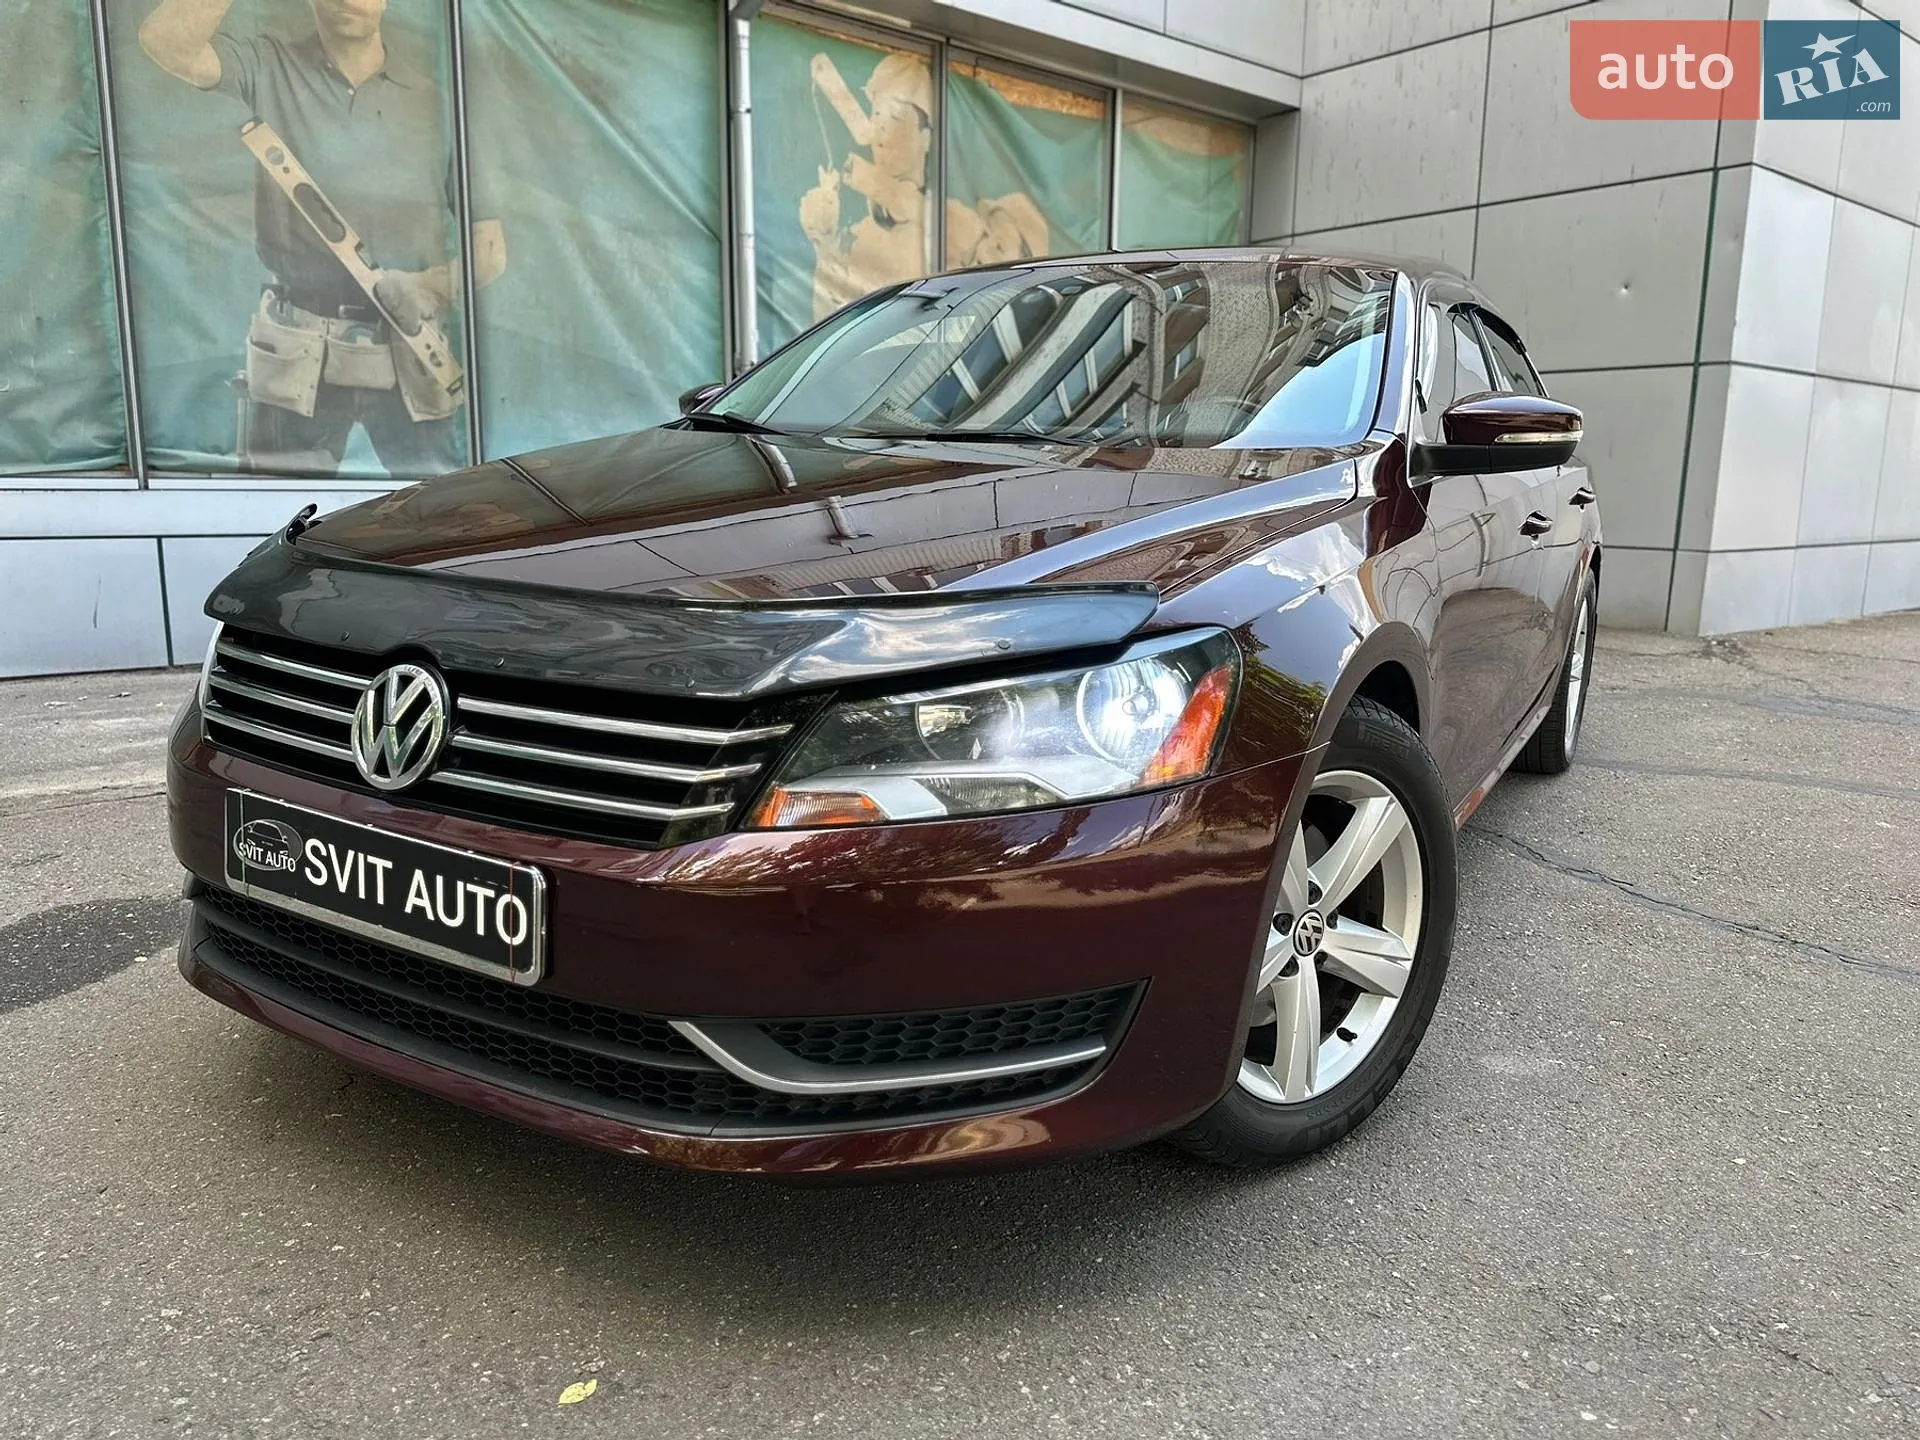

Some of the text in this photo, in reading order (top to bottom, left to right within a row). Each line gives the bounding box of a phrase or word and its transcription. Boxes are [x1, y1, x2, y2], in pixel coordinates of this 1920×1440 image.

[239, 842, 296, 872] SVIT AUTO
[304, 838, 528, 946] SVIT AUTO
